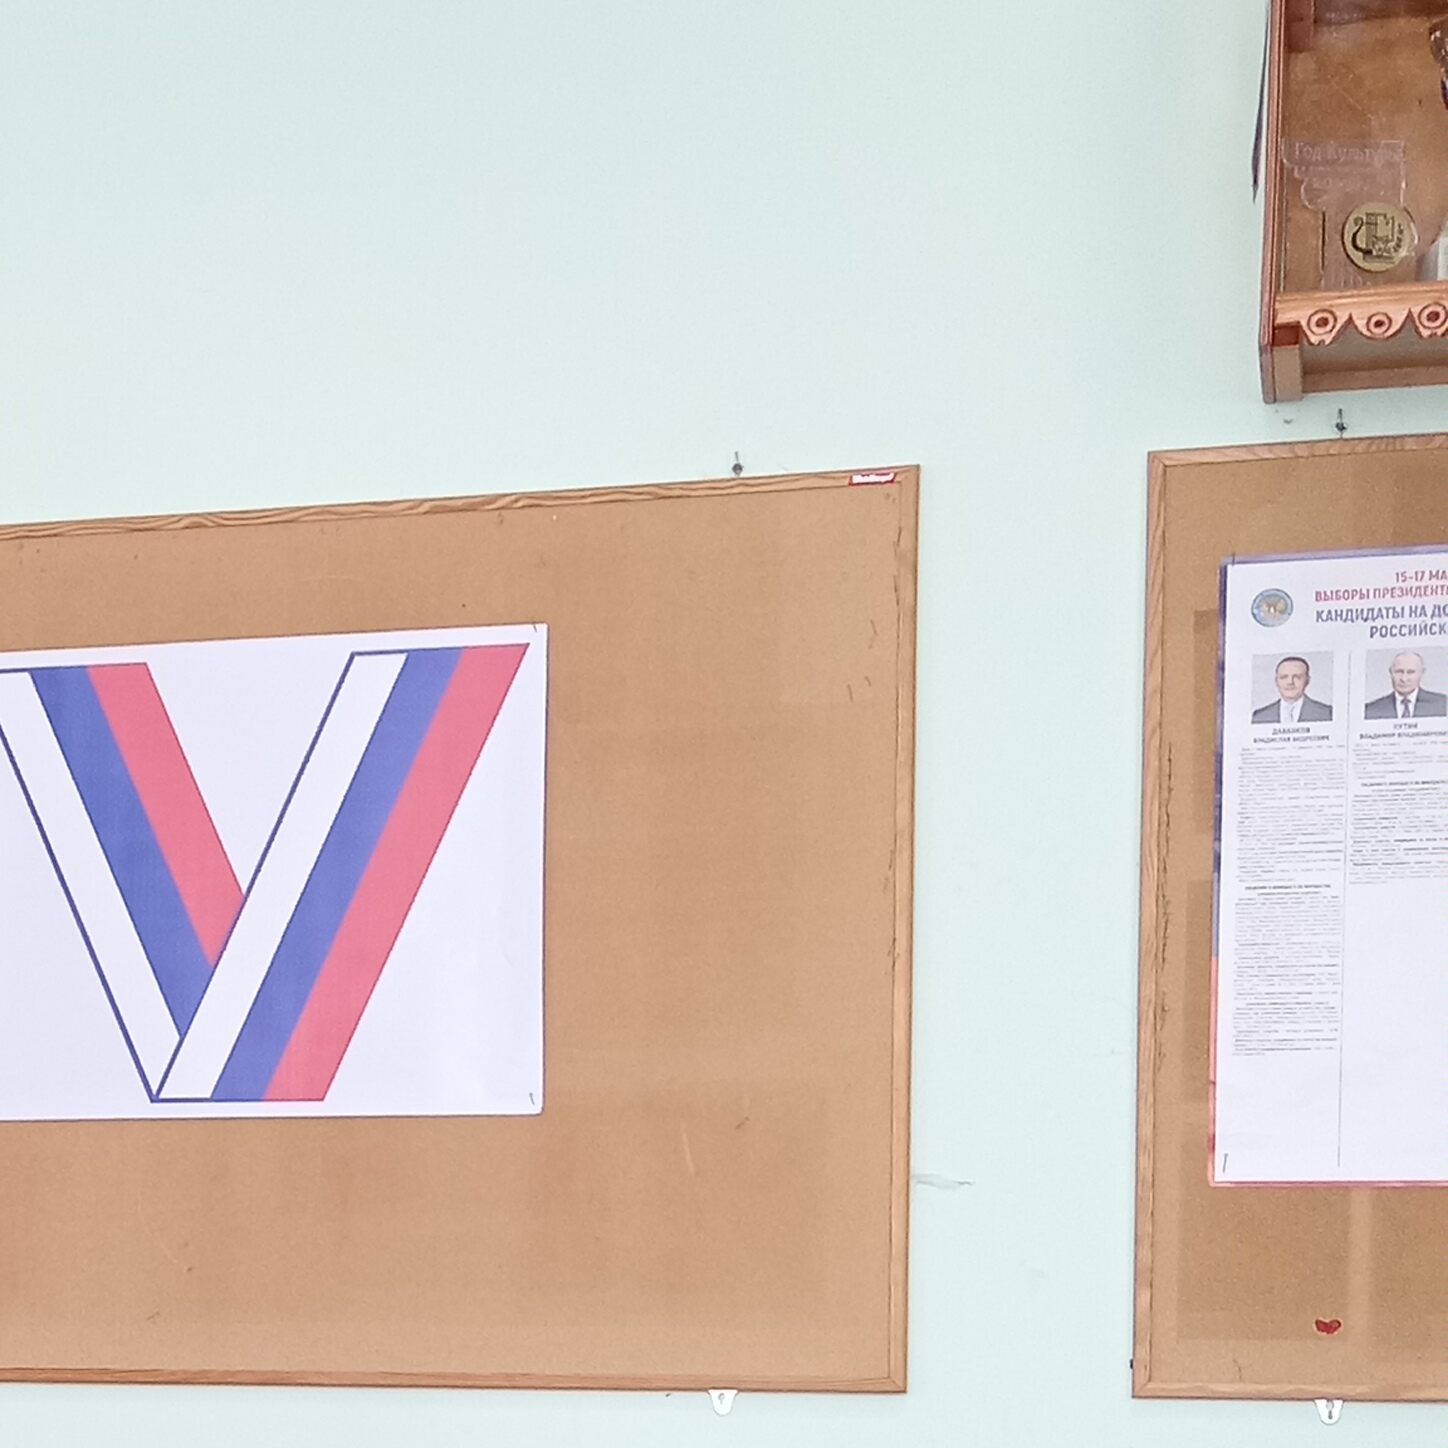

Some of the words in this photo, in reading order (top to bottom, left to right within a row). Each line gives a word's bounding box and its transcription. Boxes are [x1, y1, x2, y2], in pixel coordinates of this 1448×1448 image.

[1395, 570, 1425, 582] 15-17
[1315, 587, 1370, 602] ВЫБОРЫ
[1315, 605, 1405, 623] КАНДИДАТЫ
[1408, 604, 1428, 618] НА
[1369, 620, 1447, 639] РОССИЙСК
